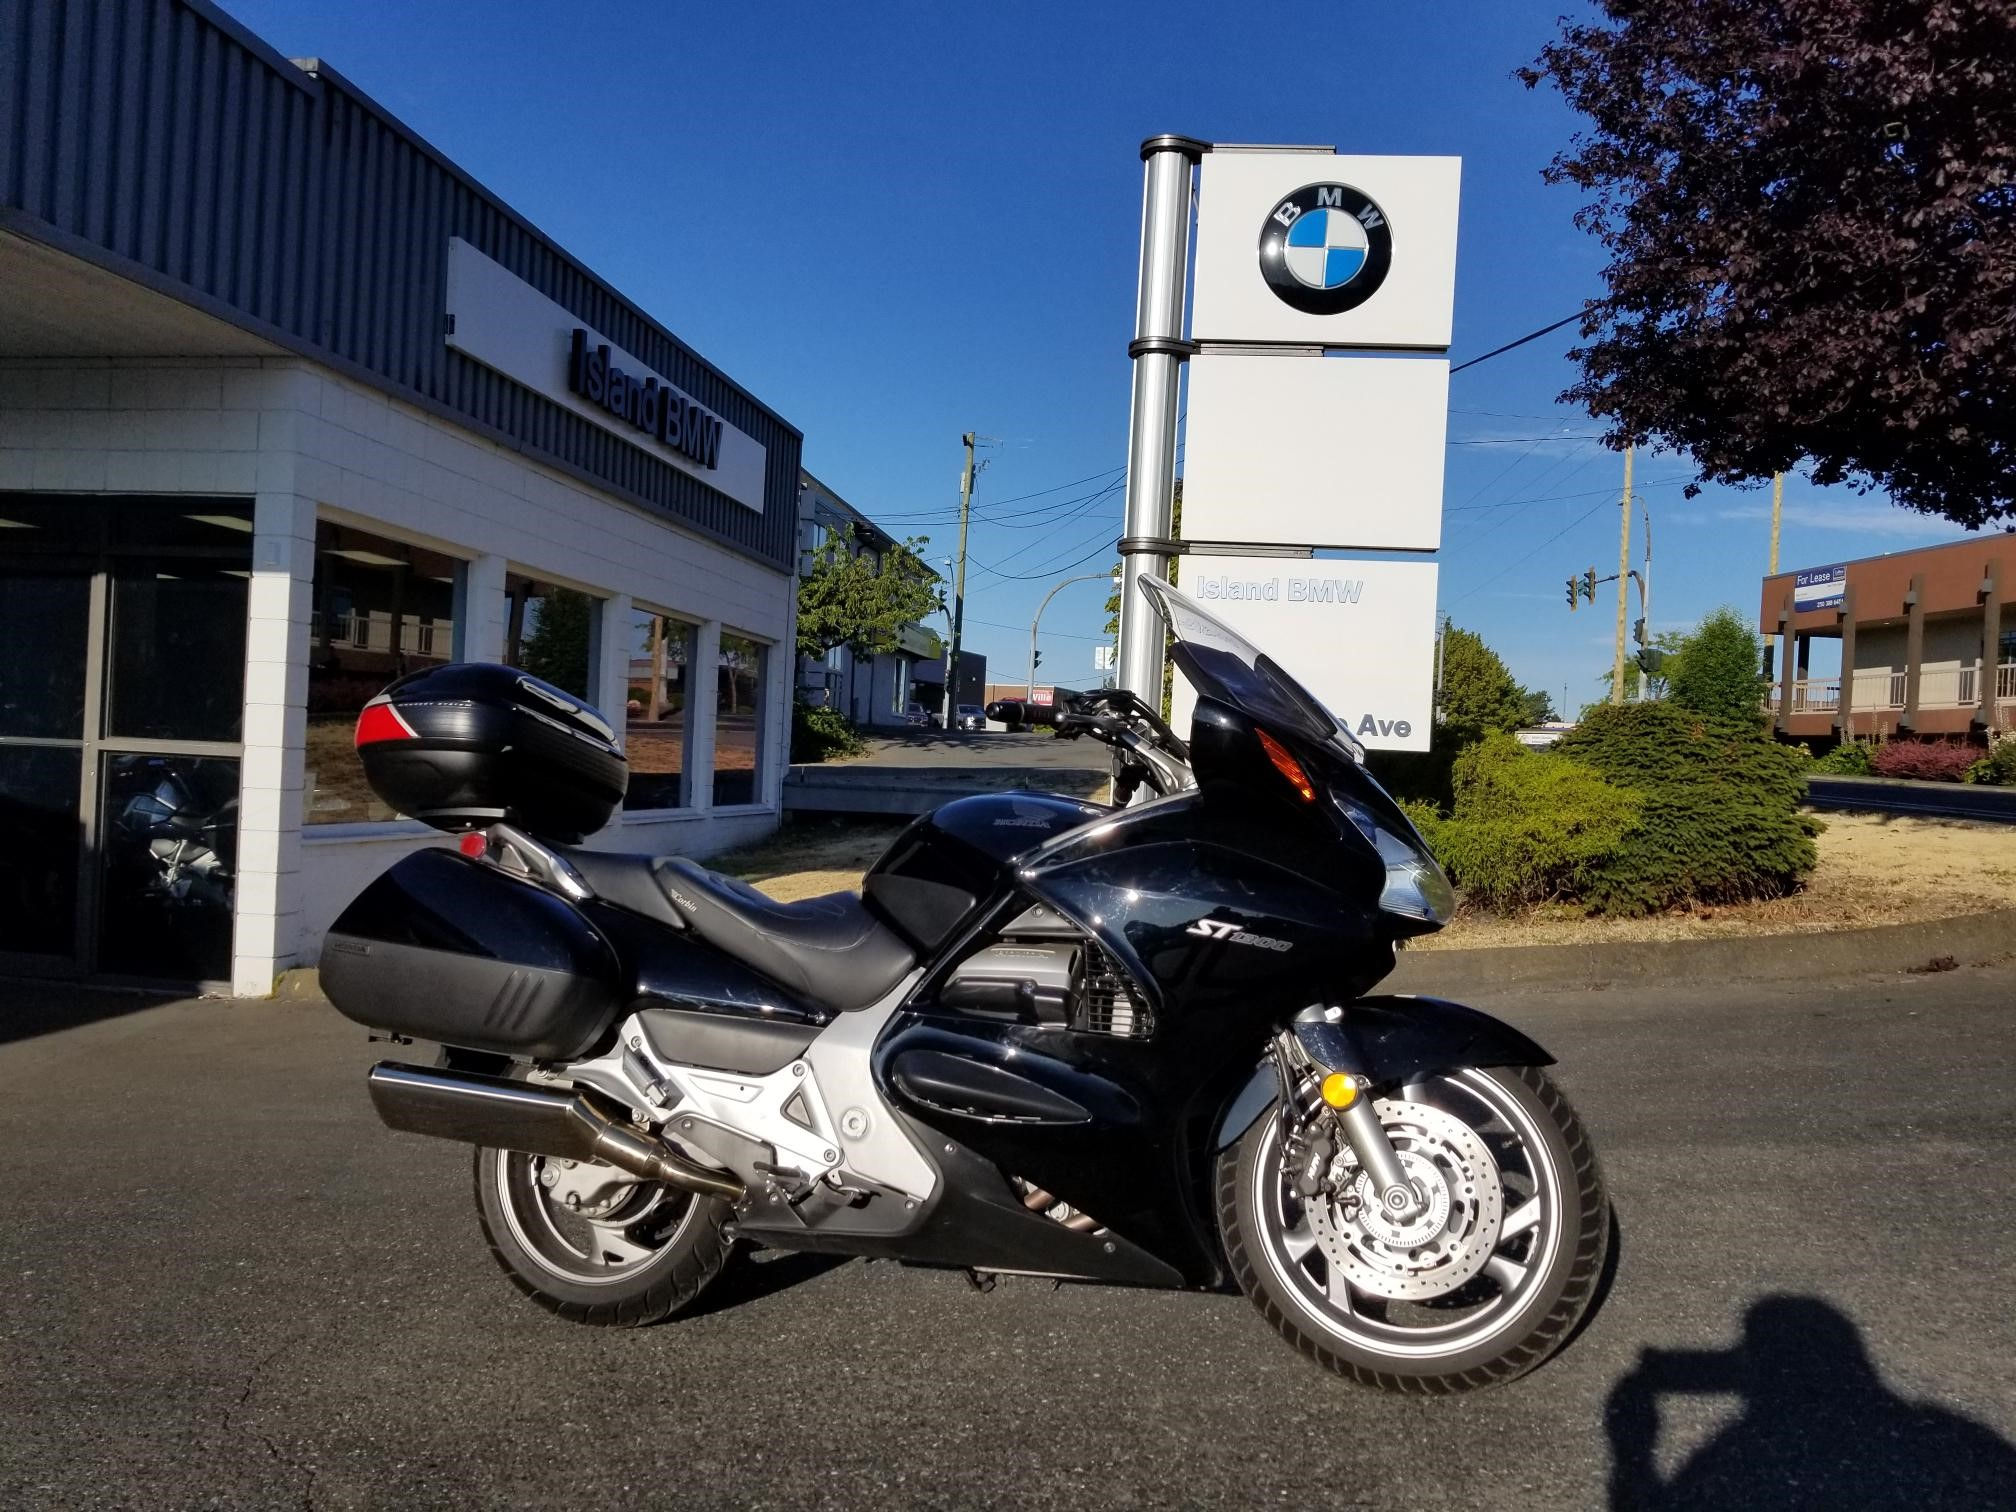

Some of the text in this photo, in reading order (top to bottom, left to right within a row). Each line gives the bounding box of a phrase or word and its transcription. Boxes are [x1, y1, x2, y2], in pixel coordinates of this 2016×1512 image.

[1274, 187, 1384, 231] BMW
[568, 328, 723, 471] Island BMW
[1196, 575, 1364, 604] Island BMW
[1797, 575, 1809, 586] For
[1810, 572, 1831, 584] Lease
[1356, 713, 1412, 738] Ave
